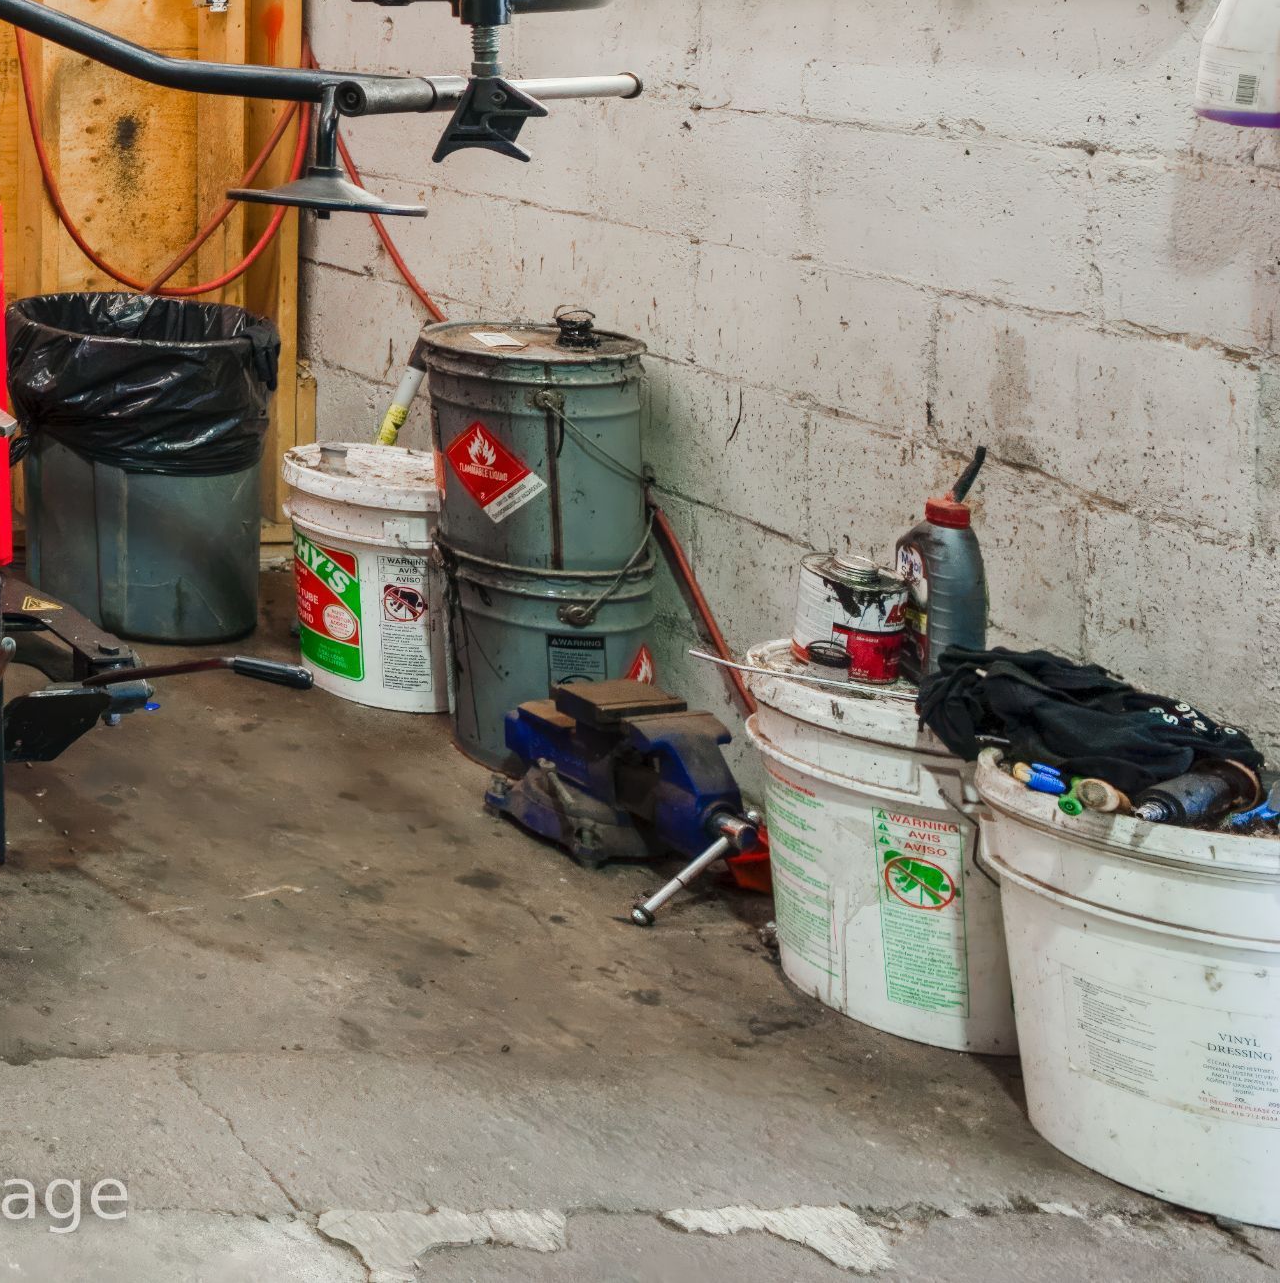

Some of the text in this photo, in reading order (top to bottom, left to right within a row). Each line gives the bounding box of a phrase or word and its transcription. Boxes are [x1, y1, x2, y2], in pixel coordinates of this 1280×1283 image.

[387, 557, 429, 566] WARNING
[395, 576, 421, 584] AVISO
[558, 638, 601, 647] WARNING
[889, 812, 960, 833] WARNING
[908, 830, 941, 843] AVIS
[903, 842, 947, 857] AVISO
[1217, 1032, 1262, 1048] VINYL
[1207, 1042, 1273, 1062] DRESSING
